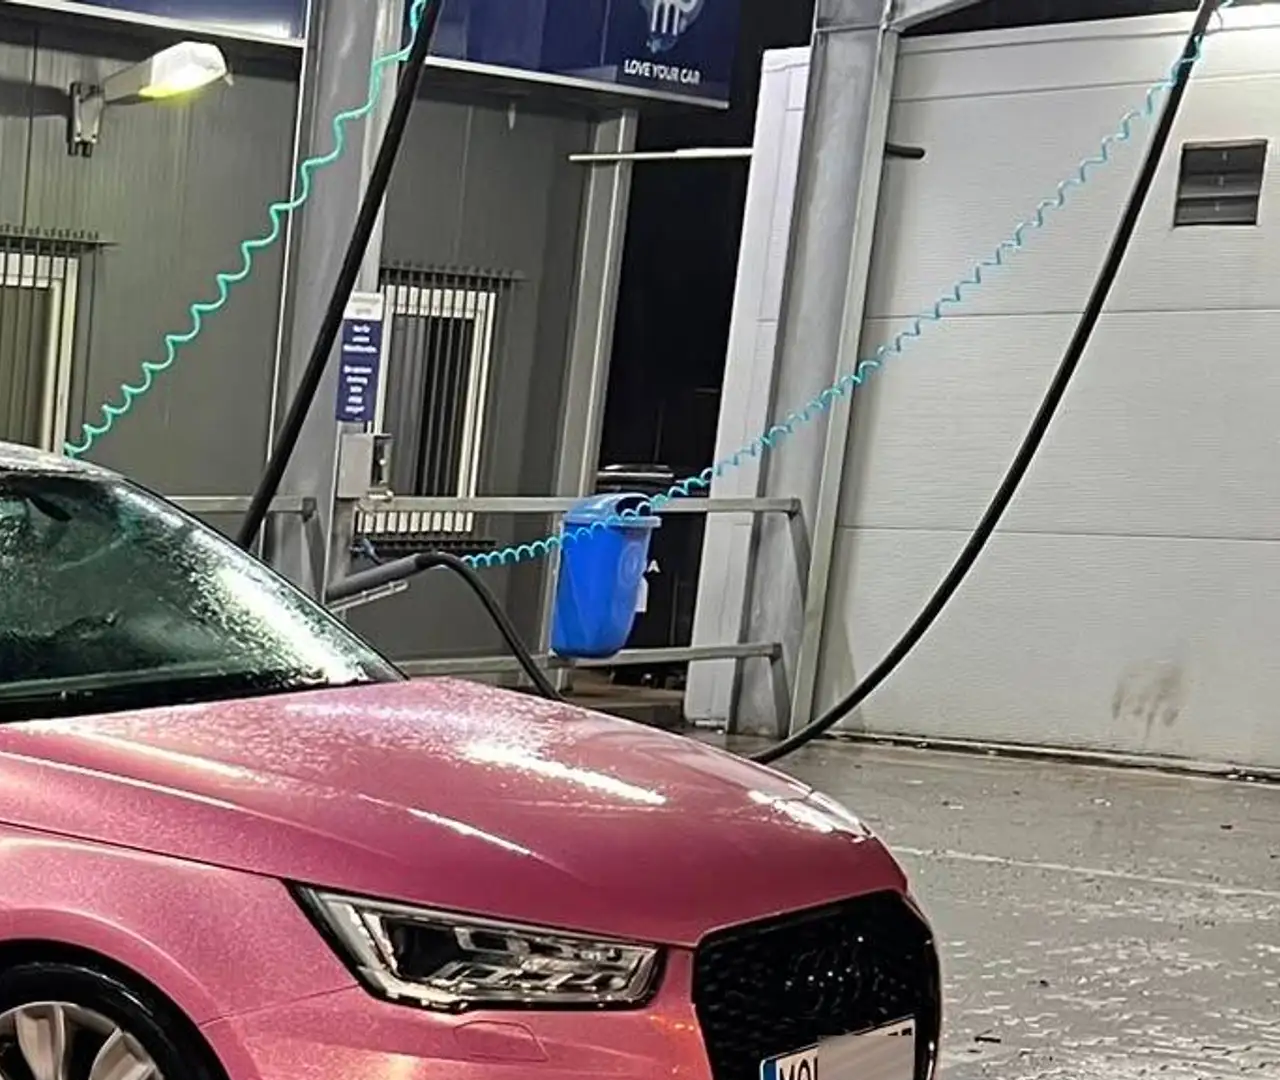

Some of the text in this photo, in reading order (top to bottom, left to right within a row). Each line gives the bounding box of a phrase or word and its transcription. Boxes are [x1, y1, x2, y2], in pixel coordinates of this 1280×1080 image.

[623, 59, 701, 84] LOVE YOUR CAR
